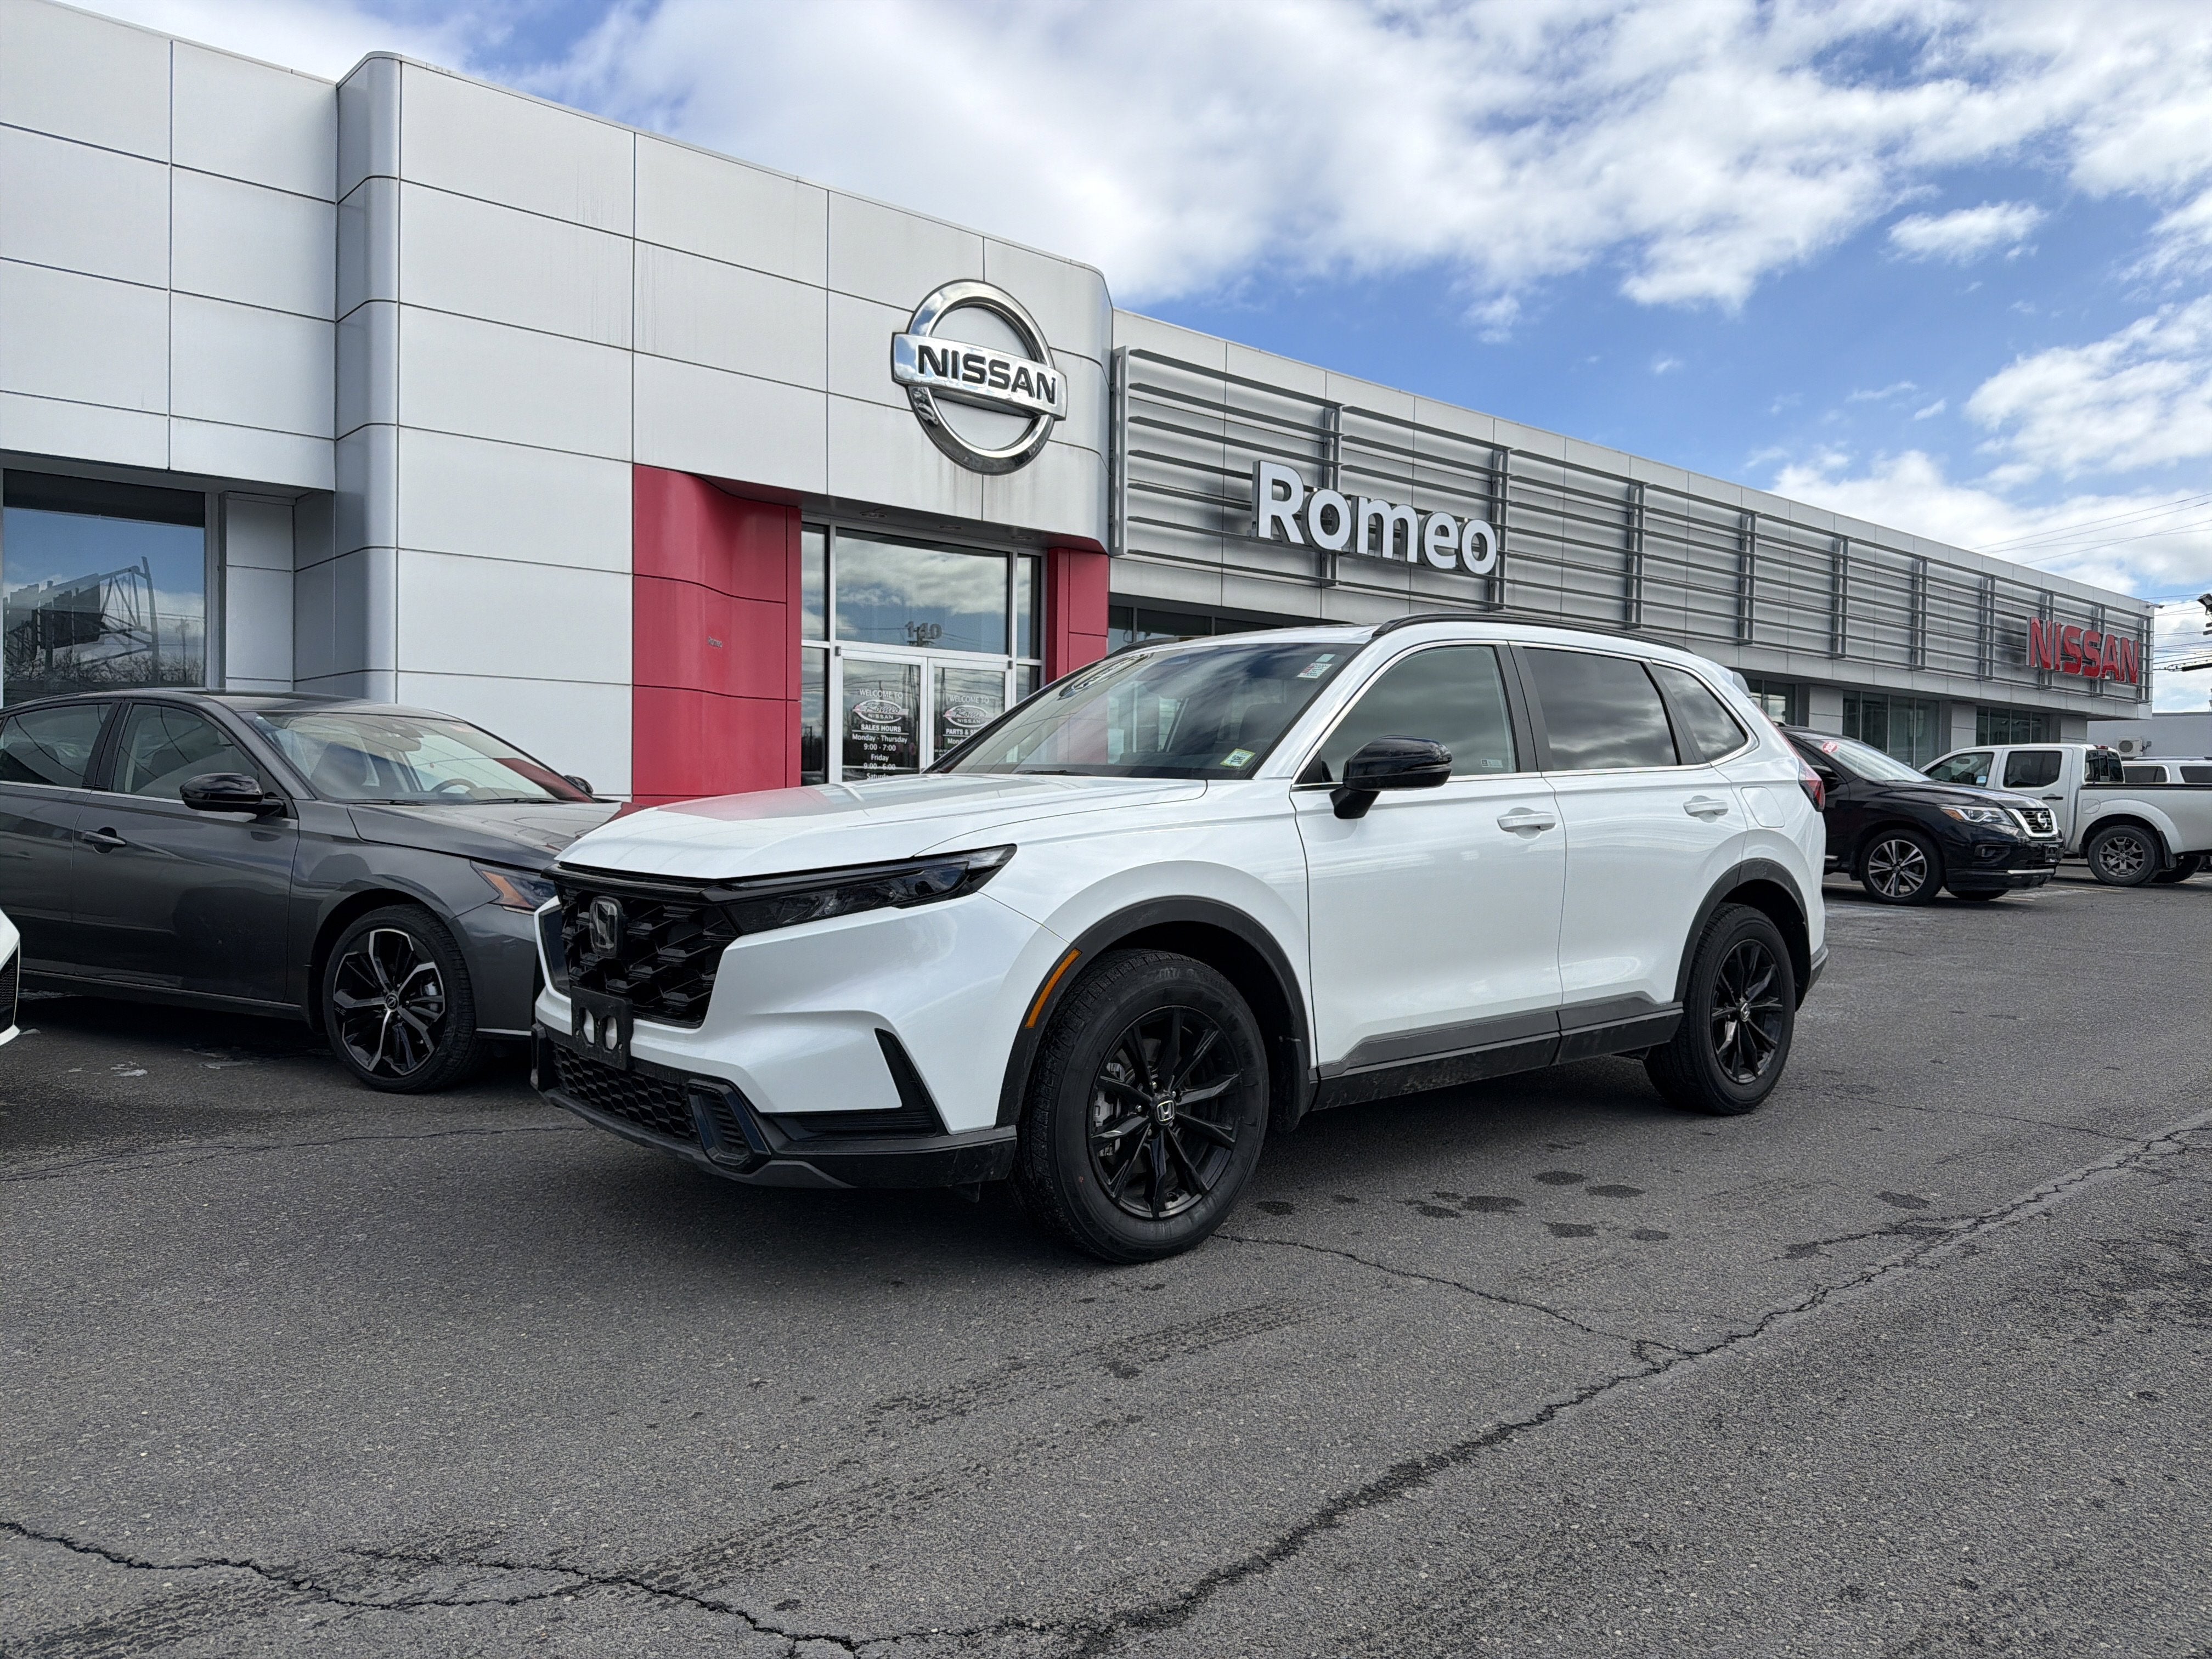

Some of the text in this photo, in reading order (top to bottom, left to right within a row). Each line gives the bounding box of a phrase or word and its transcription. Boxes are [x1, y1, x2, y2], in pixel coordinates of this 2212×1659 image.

[917, 345, 1057, 405] NISSAN
[1253, 460, 1497, 575] Romeo
[905, 621, 942, 639] 140
[2027, 616, 2139, 684] NISSAN
[860, 689, 893, 698] WELCOME
[950, 696, 979, 704] WELCOME
[852, 733, 876, 743] Monday
[881, 735, 908, 744] Thursday
[871, 754, 889, 762] Friday
